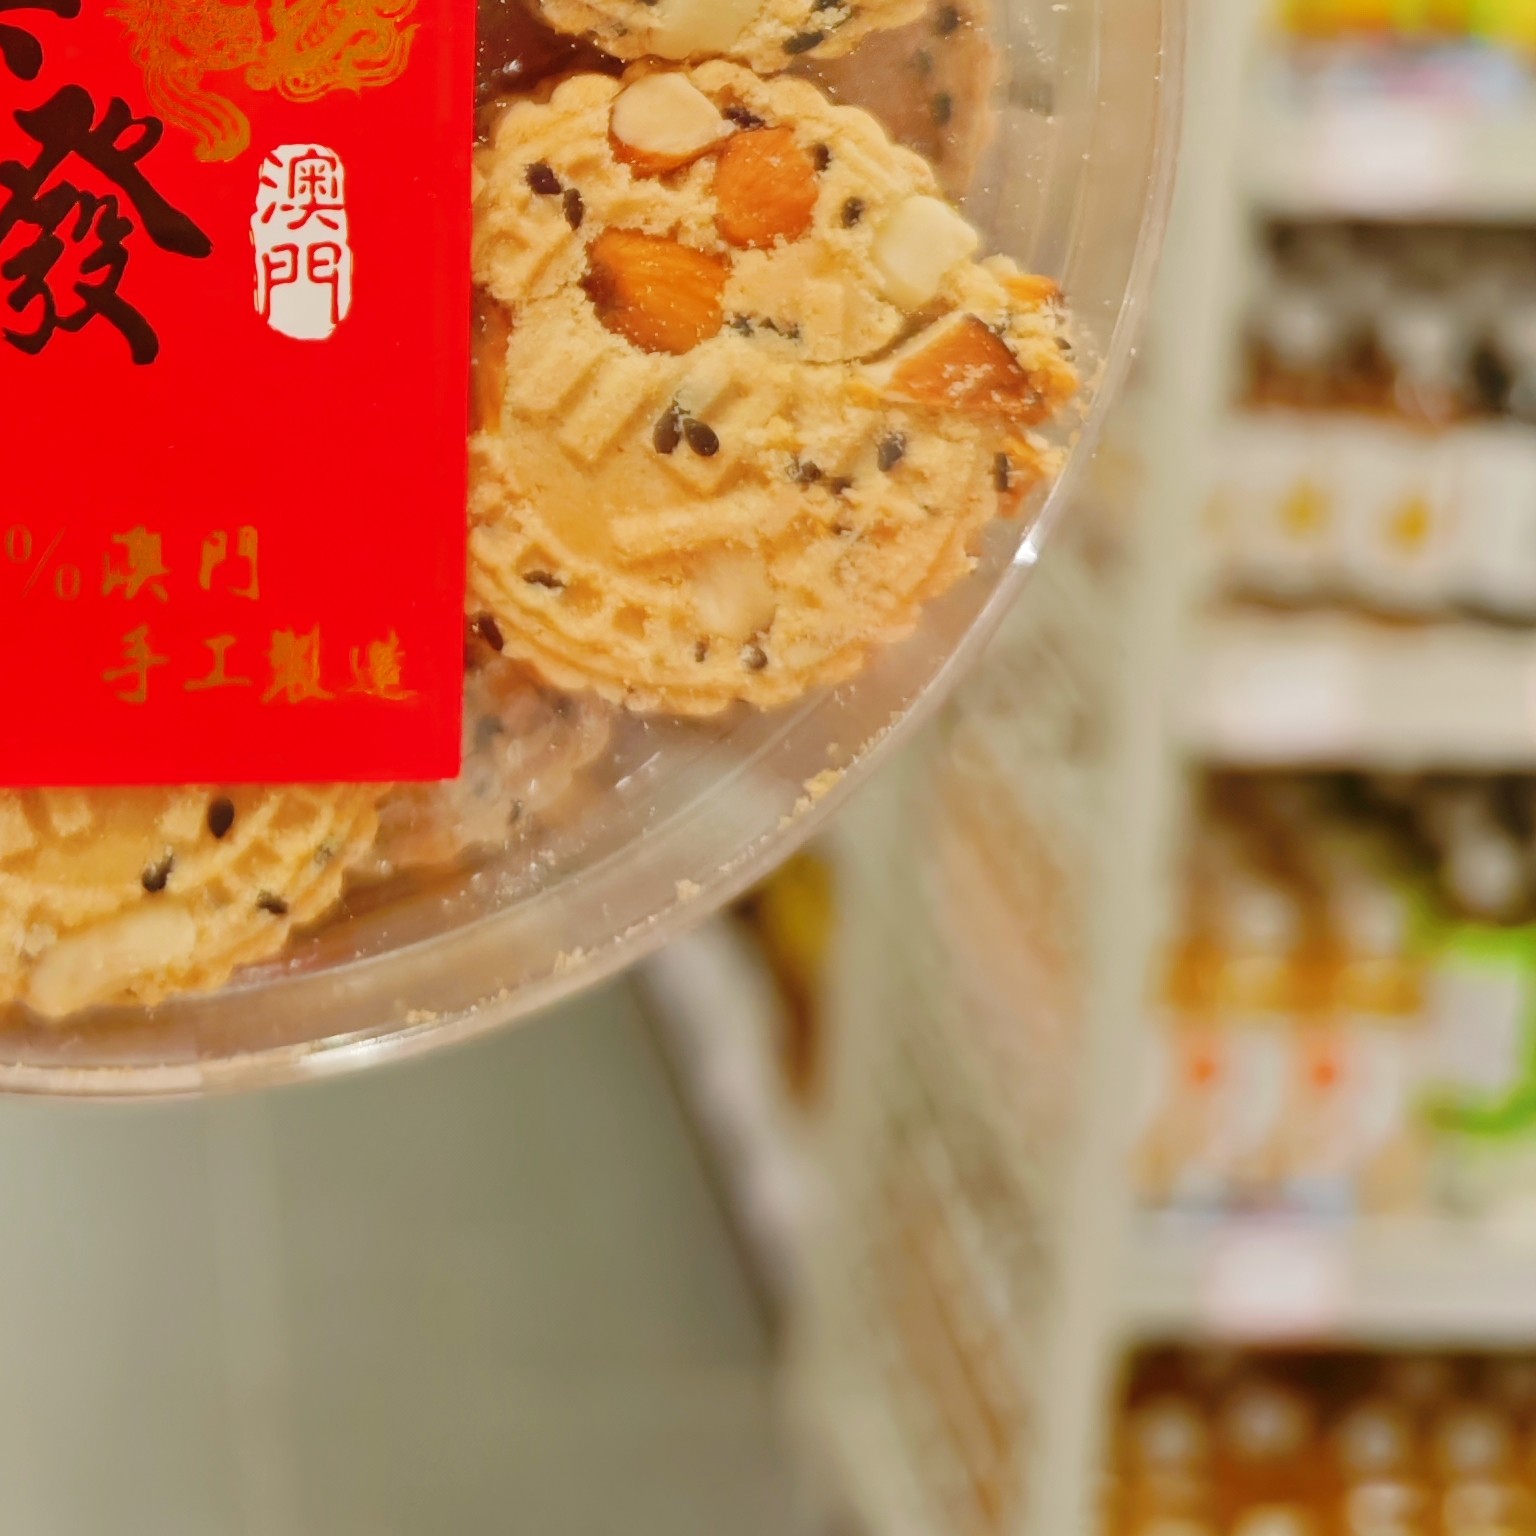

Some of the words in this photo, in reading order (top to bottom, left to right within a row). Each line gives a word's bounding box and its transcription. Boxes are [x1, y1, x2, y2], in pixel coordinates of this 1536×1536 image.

[254, 146, 352, 338] 澳門
[100, 622, 416, 704] 手工製造
